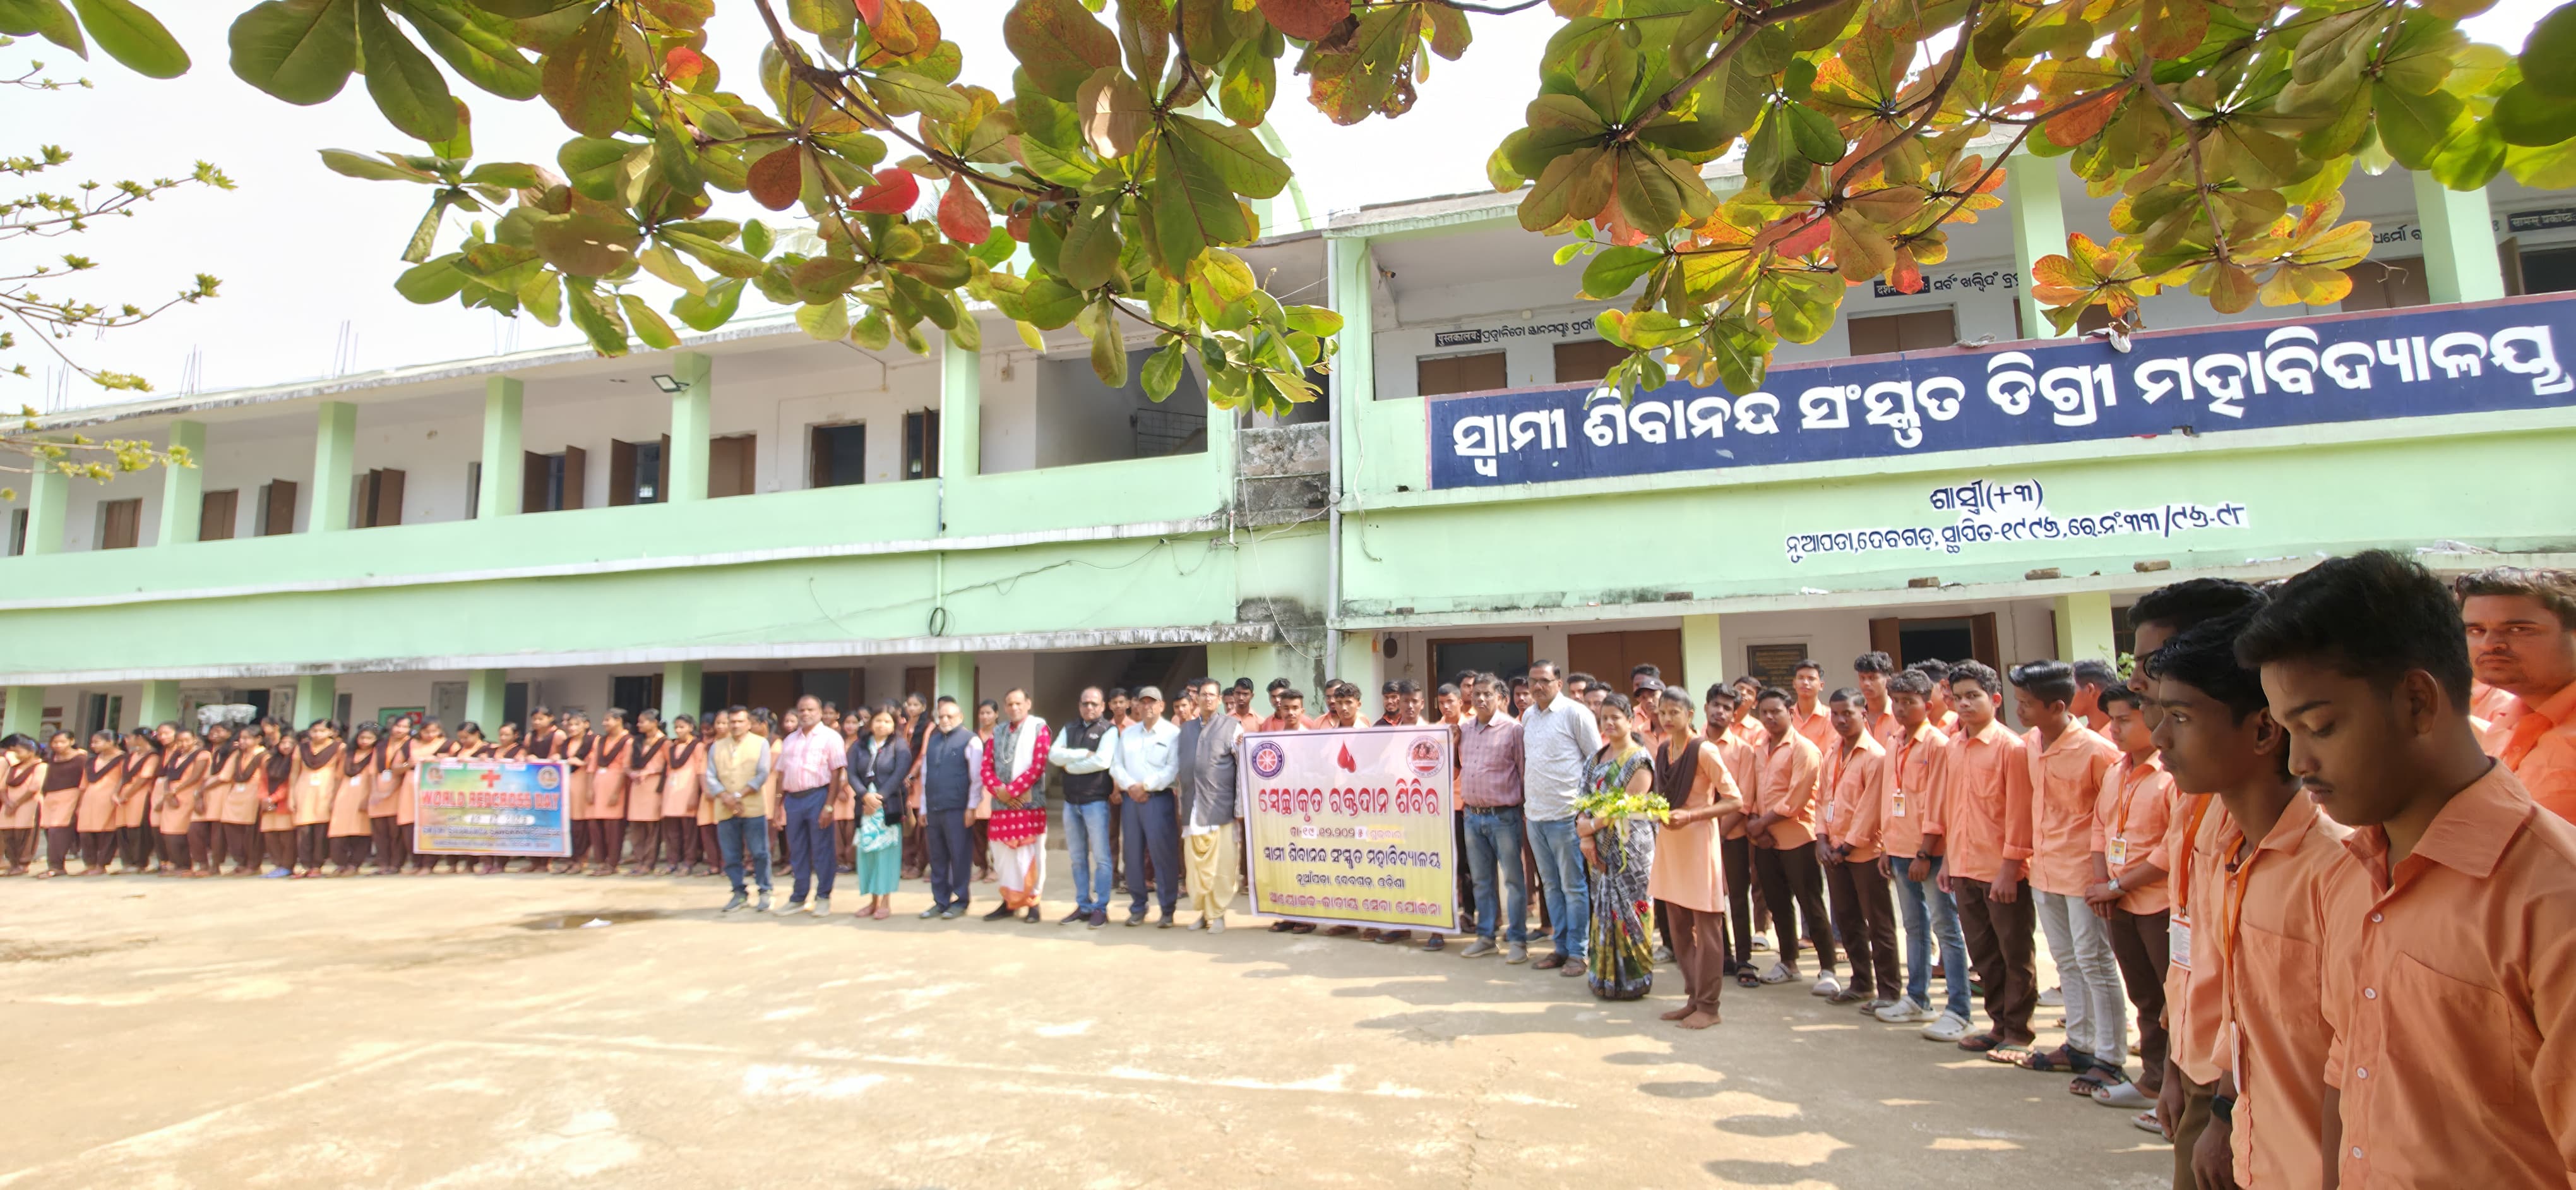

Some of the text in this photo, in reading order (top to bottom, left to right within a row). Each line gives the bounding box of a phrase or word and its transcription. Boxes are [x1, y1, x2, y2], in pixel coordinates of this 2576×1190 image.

[1453, 325, 2576, 478] ସ୍ୱାମୀ ଶିବାନନ୍ଦ ସଂସ୍କୃତ ଡିଗ୍ରୀ ମହାବିଦ୍ୟାଳୟ
[421, 790, 465, 808] WORLD
[1328, 787, 1389, 816] ରକ୍ତଦାନ
[1395, 778, 1440, 816] ଶିବିର
